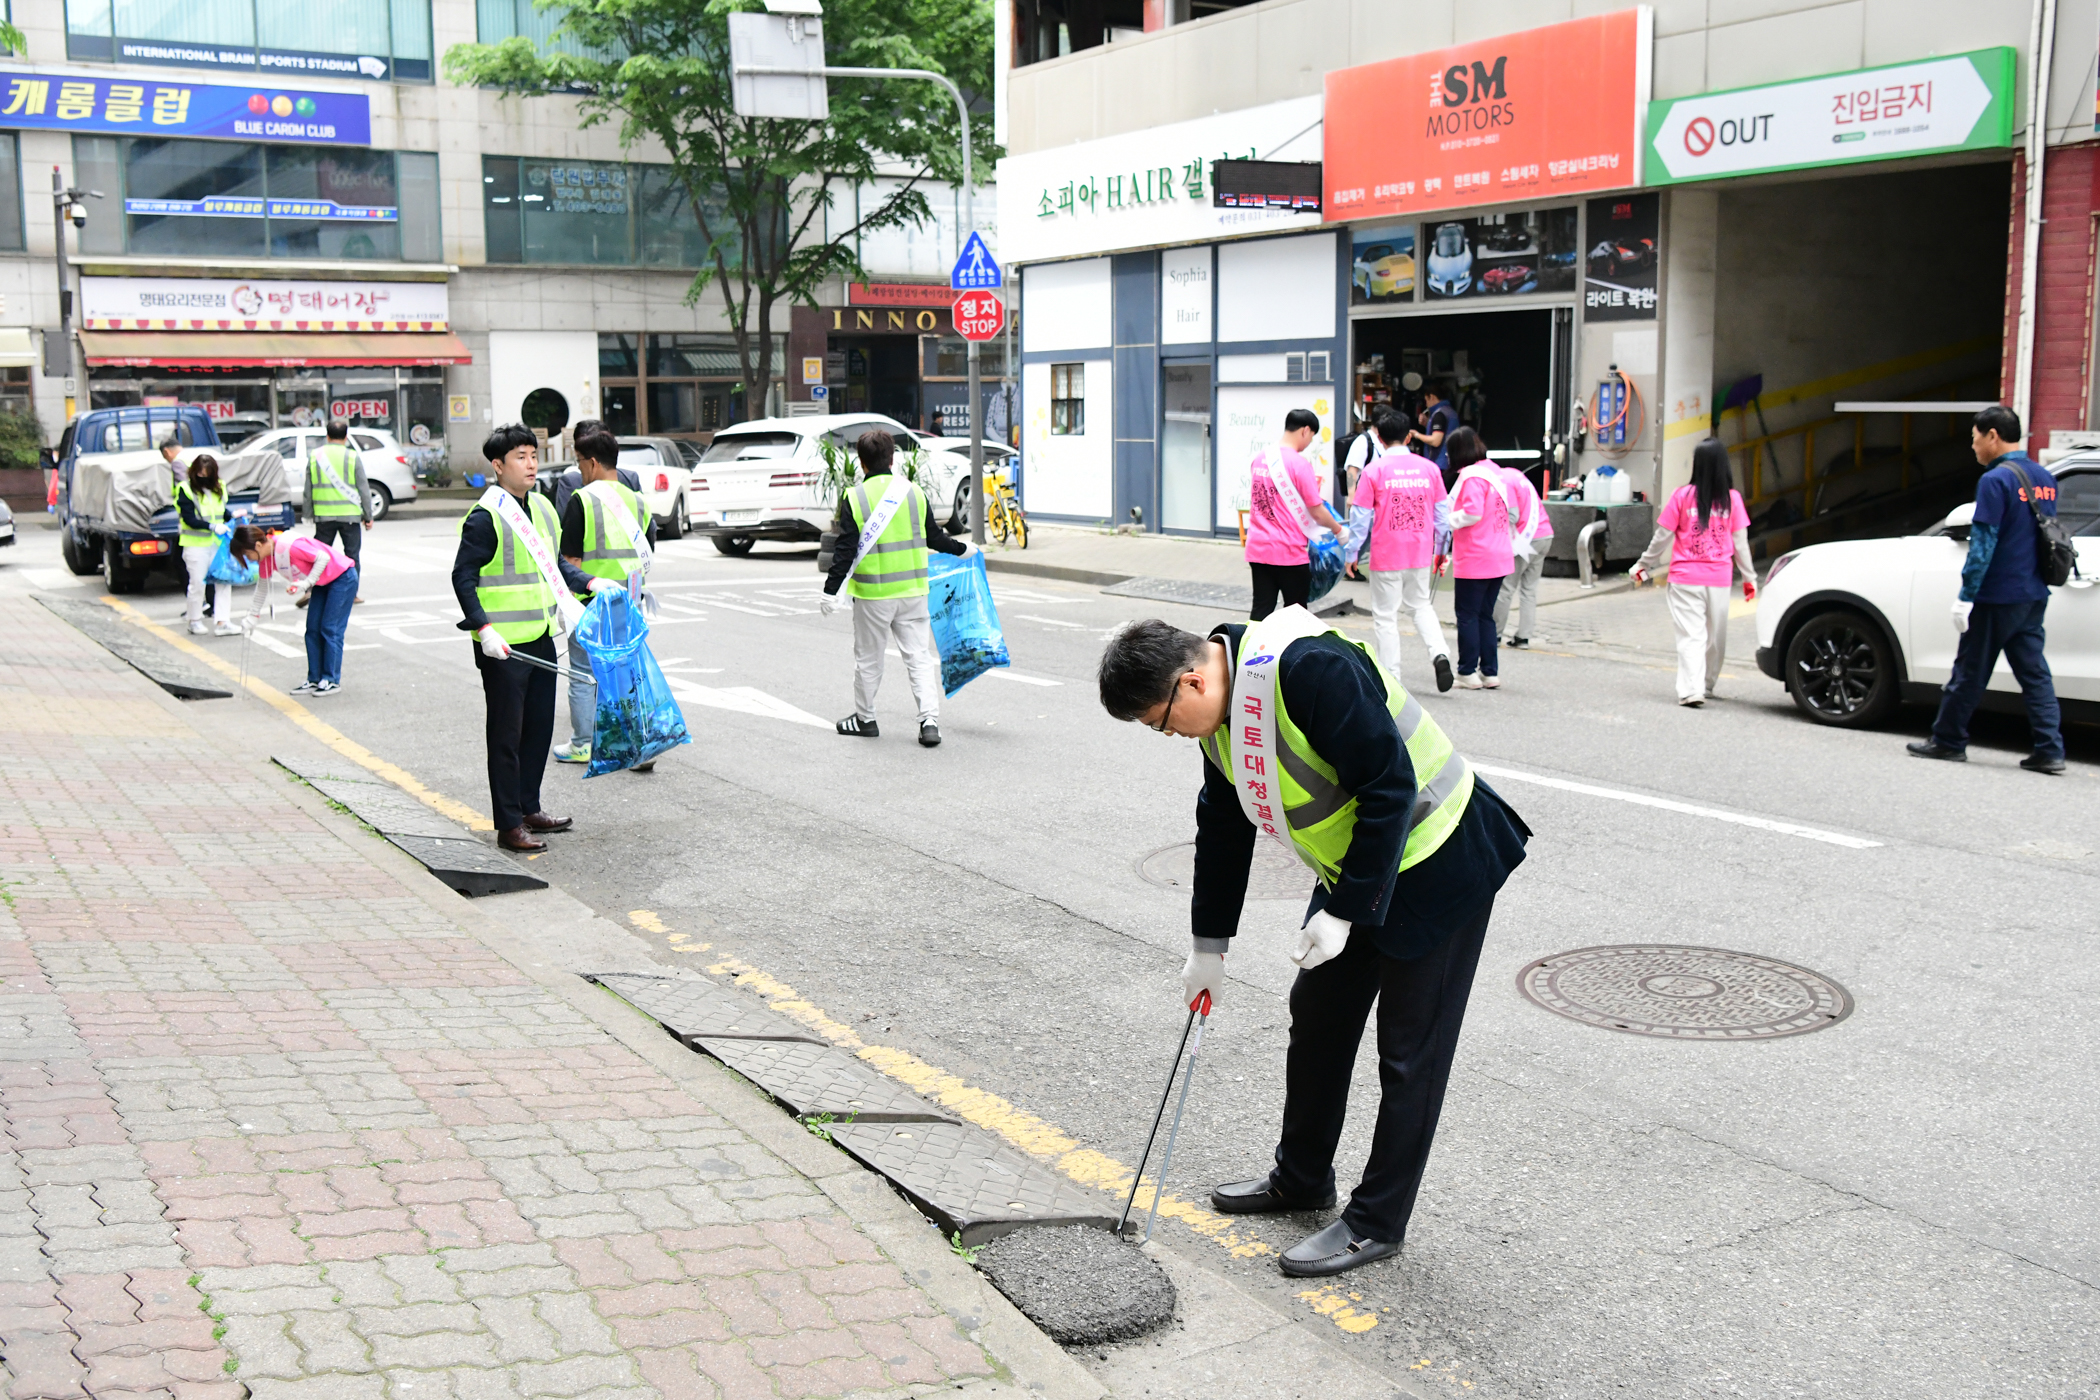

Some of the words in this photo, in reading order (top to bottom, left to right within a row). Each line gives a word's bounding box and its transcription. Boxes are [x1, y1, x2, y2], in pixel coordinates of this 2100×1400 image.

[124, 45, 218, 63] INTERNATIONAL
[219, 50, 255, 66] BRAIN
[260, 55, 305, 70] SPORTS
[308, 58, 357, 72] STADIUM
[1430, 71, 1442, 108] THE
[1443, 56, 1507, 107] SM
[1, 78, 191, 126] 캐롬클럽
[1832, 80, 1932, 125] 진입금지
[1426, 102, 1514, 138] MOTORS
[235, 121, 263, 135] BLUE
[266, 122, 304, 137] CAROM
[307, 124, 335, 139] CLUB
[1720, 114, 1774, 146] OUT
[1037, 175, 1098, 217] 소피아
[1107, 166, 1175, 209] HAIR
[959, 277, 996, 286] 횡단보도
[1169, 268, 1207, 286] Sophia
[140, 292, 226, 307] 명태요리전문점
[268, 290, 389, 315] 명태어장
[961, 298, 997, 317] 정지
[1586, 290, 1624, 307] 라이트
[1627, 287, 1655, 309] 복원
[1177, 309, 1200, 323] Hair
[961, 319, 997, 336] STOP
[332, 401, 389, 418] OPEN
[1229, 412, 1265, 431] Beauty
[1385, 478, 1430, 490] FRIENDS
[1246, 669, 1266, 681] 안산시
